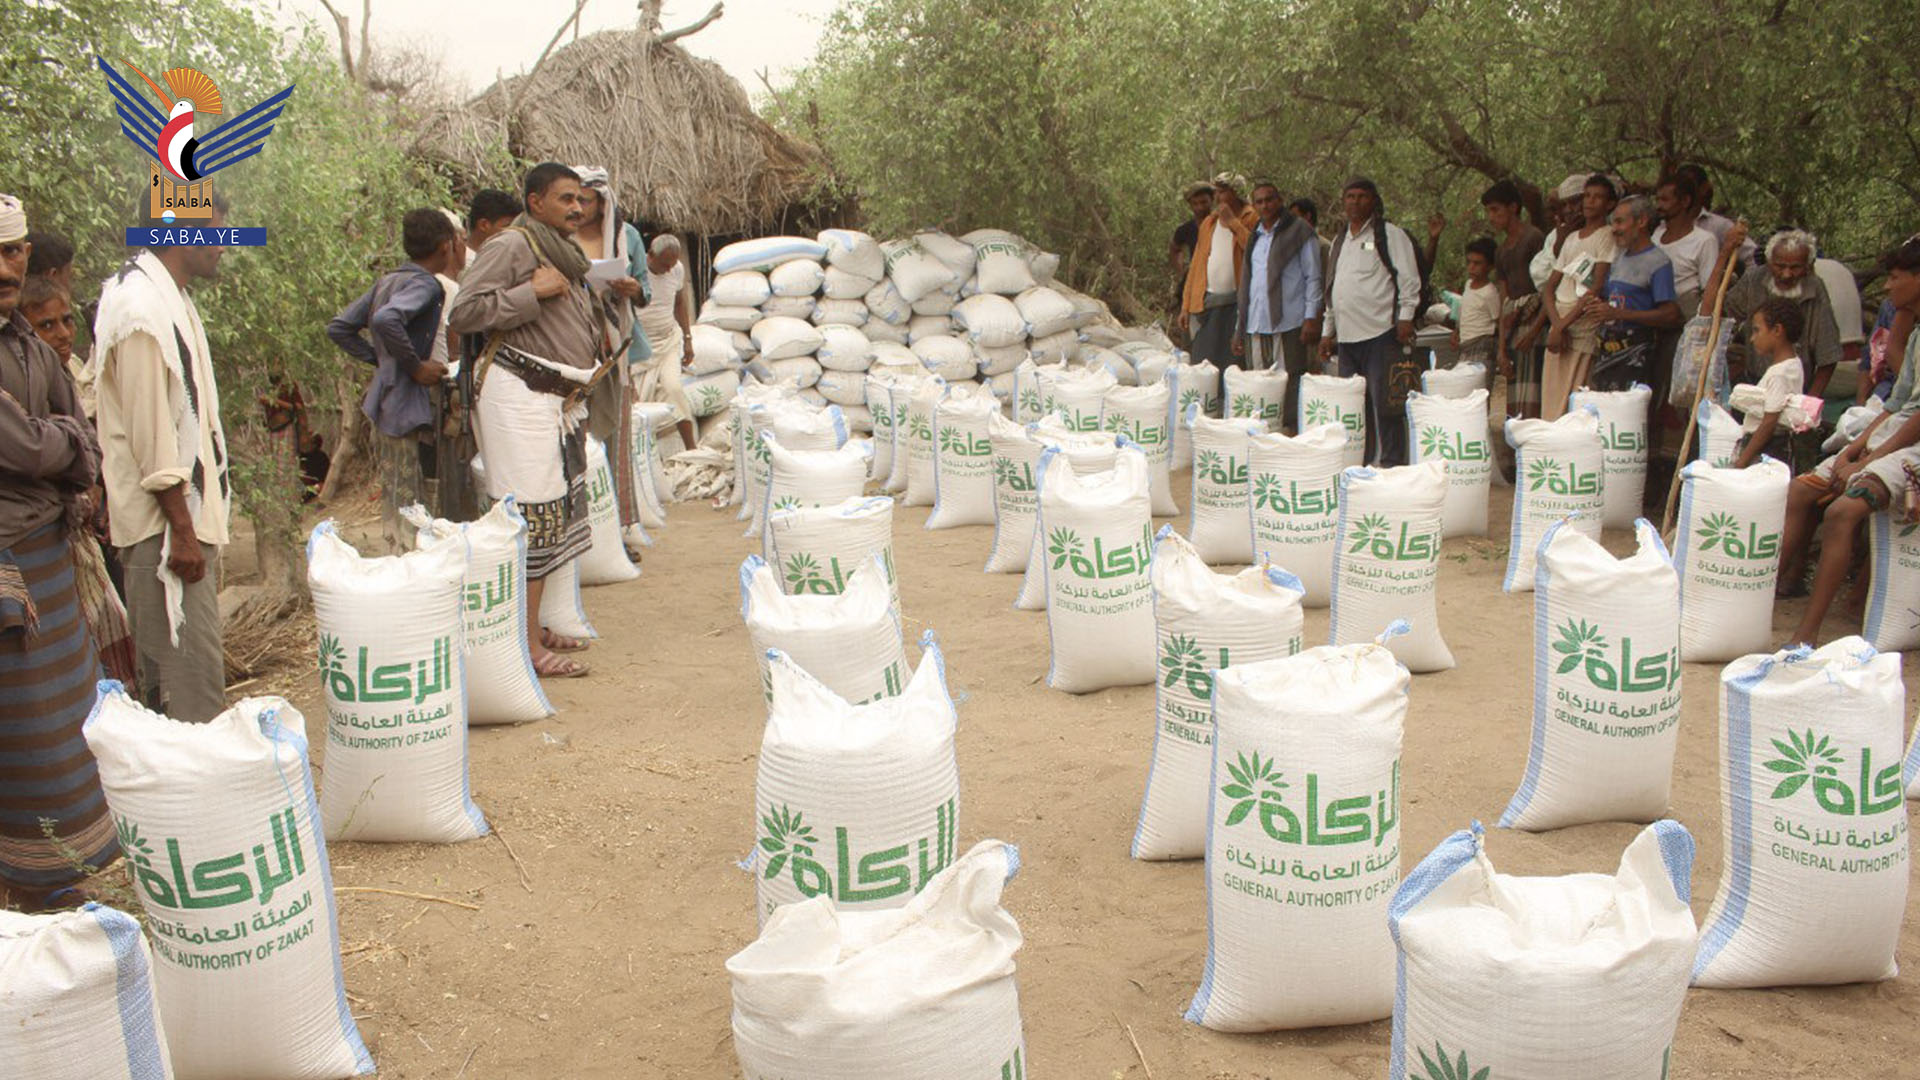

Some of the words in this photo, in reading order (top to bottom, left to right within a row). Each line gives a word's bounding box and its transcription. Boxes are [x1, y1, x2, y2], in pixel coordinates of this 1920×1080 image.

[330, 636, 452, 705] الزكاة
[350, 713, 402, 731] العامة
[1608, 701, 1657, 719] العامة
[348, 736, 404, 750] AUTHORITY
[406, 733, 421, 746] OF
[1603, 723, 1657, 738] AUTHORITY
[1773, 816, 1841, 846] للزكاة
[135, 807, 306, 909] الزكاة
[1226, 845, 1286, 876] للزكاة
[1291, 860, 1361, 882] العامة
[1771, 843, 1837, 872] GENERAL
[1224, 872, 1283, 904] GENERAL
[1286, 886, 1362, 908] AUTHORITY
[1364, 882, 1380, 902] OF
[176, 921, 248, 945] العامة
[177, 949, 253, 970] AUTHORITY
[256, 940, 275, 960] OF
[277, 919, 315, 951] ZAKAT
